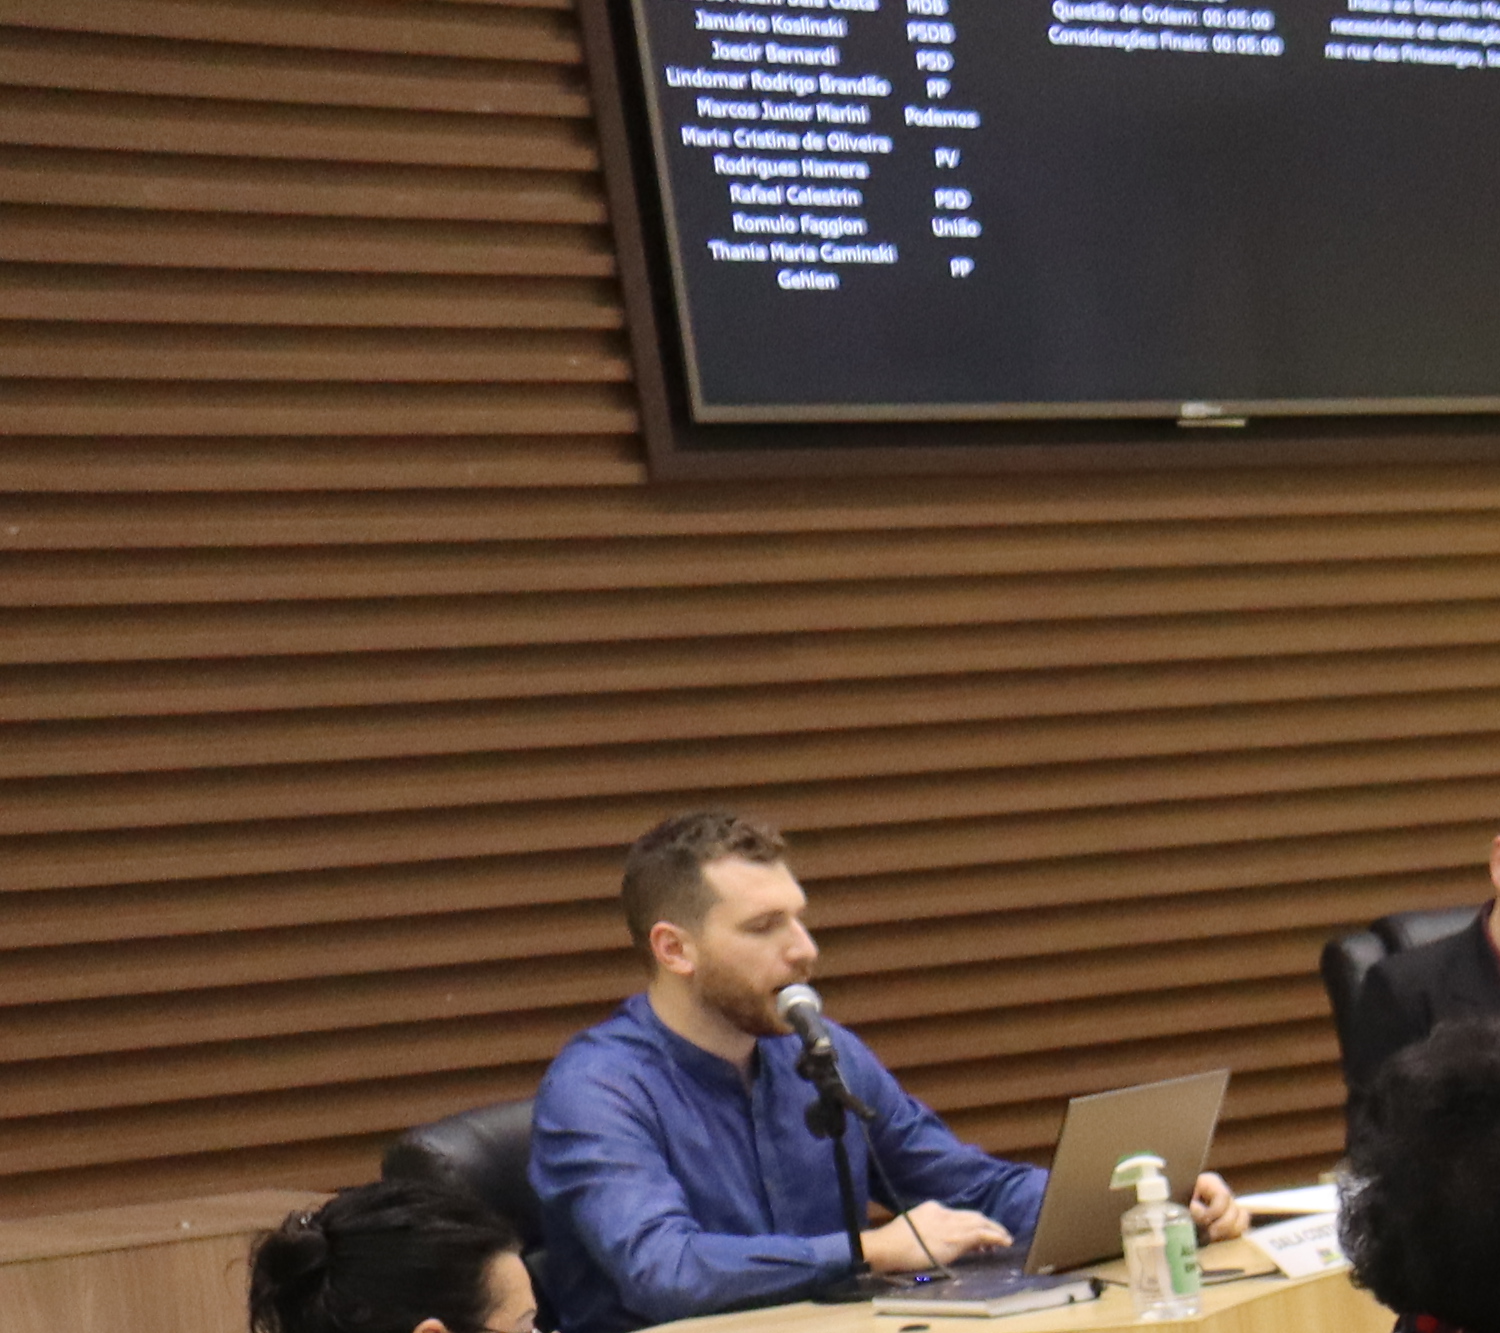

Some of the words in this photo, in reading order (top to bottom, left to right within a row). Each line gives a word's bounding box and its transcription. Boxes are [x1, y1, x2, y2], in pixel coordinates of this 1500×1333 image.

[907, 0, 948, 15] MDB
[1052, 0, 1119, 22] Questão
[1119, 4, 1142, 23] de
[1141, 5, 1198, 26] Ordem:
[1202, 9, 1274, 30] 00:05:00
[696, 10, 770, 33] Januário
[771, 15, 847, 37] Koslinski
[907, 22, 955, 43] PSDB
[1048, 25, 1160, 52] Considerações
[1159, 31, 1208, 52] Finais:
[1212, 34, 1283, 56] 00:05:00
[712, 40, 763, 61] Joecir
[765, 43, 839, 65] Bernardi
[916, 50, 954, 71] PSD
[666, 67, 749, 89] Lindomar
[751, 70, 818, 96] Rodrigo
[819, 74, 891, 96] Brandão
[927, 79, 950, 98] PP
[697, 98, 760, 119] Marcos
[762, 101, 814, 121] Junior
[816, 103, 869, 124] Marini
[905, 106, 980, 128] Podemos
[682, 127, 731, 147] Maria
[733, 128, 800, 150] Cristina
[802, 131, 826, 151] de
[827, 131, 892, 153] Oliveira
[714, 155, 799, 180] Rodrigues
[801, 159, 869, 179] Hamera
[935, 148, 959, 168] PV
[730, 183, 785, 204] Rafael
[786, 185, 862, 206] Celestrin
[935, 189, 971, 209] PSD
[733, 213, 799, 233] Romulo
[800, 214, 867, 238] Faggion
[932, 217, 981, 237] União
[708, 240, 768, 261] Thania
[770, 243, 819, 262] Maria
[820, 243, 897, 263] Caminski
[950, 258, 973, 277] PP
[778, 270, 839, 290] Gehlen
